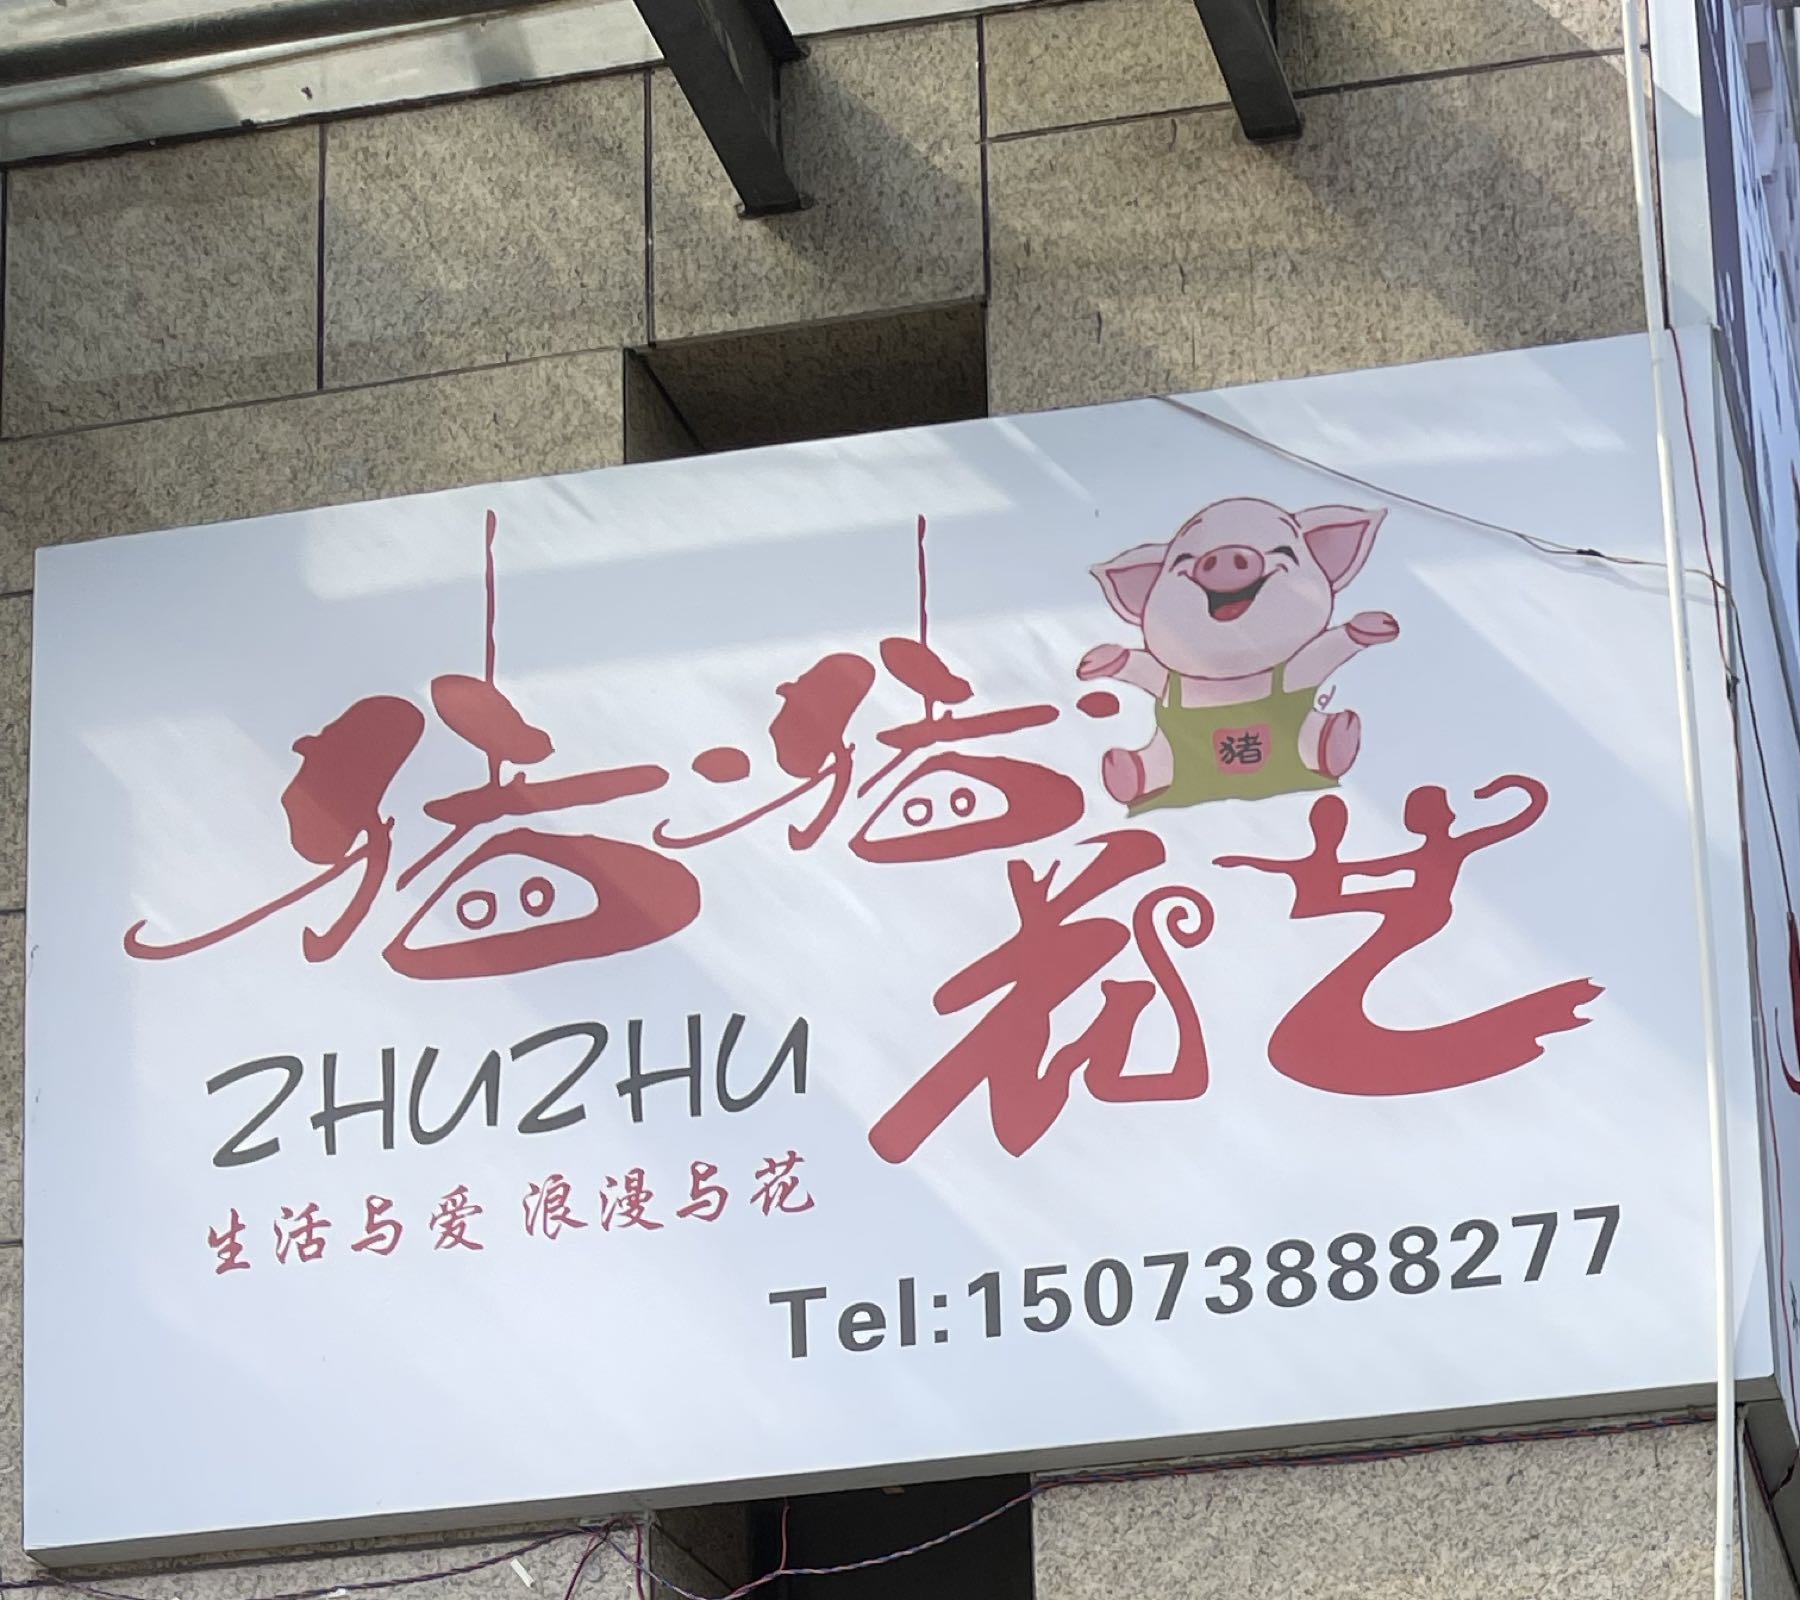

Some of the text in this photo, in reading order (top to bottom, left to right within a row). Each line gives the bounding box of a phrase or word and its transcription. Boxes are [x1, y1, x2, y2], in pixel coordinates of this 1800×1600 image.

[206, 1012, 812, 1168] ZHUZHU
[206, 1148, 816, 1278] 生活与爱 浪漫与花
[768, 1204, 1624, 1360] Tel:15073888277
